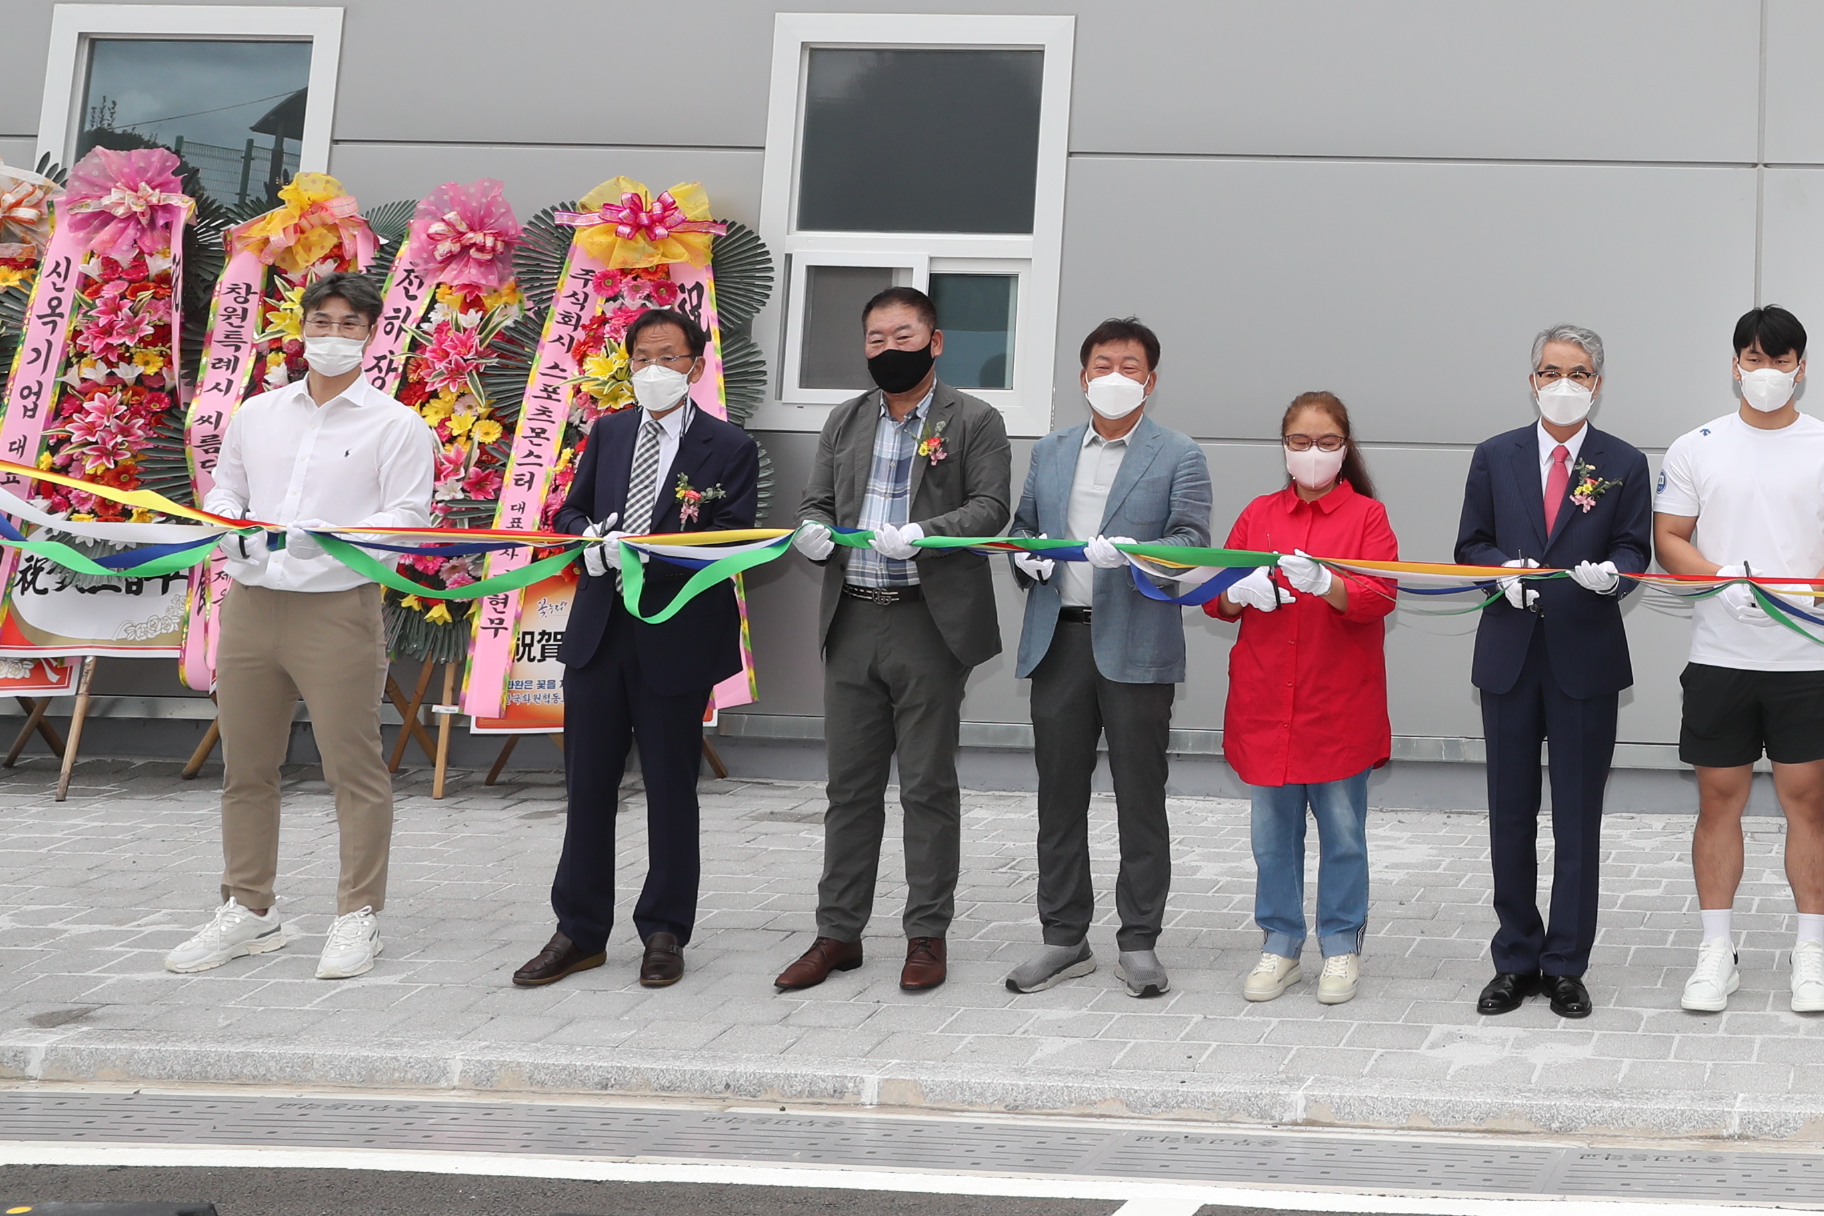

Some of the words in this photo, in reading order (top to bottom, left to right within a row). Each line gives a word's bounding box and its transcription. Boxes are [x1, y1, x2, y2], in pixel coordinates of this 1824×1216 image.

[19, 255, 72, 420] 신옥기업
[203, 282, 259, 397] 창원특례시
[547, 267, 597, 355] 주식회사
[512, 361, 568, 492] 스포츠몬스터
[498, 500, 526, 561] 대표사
